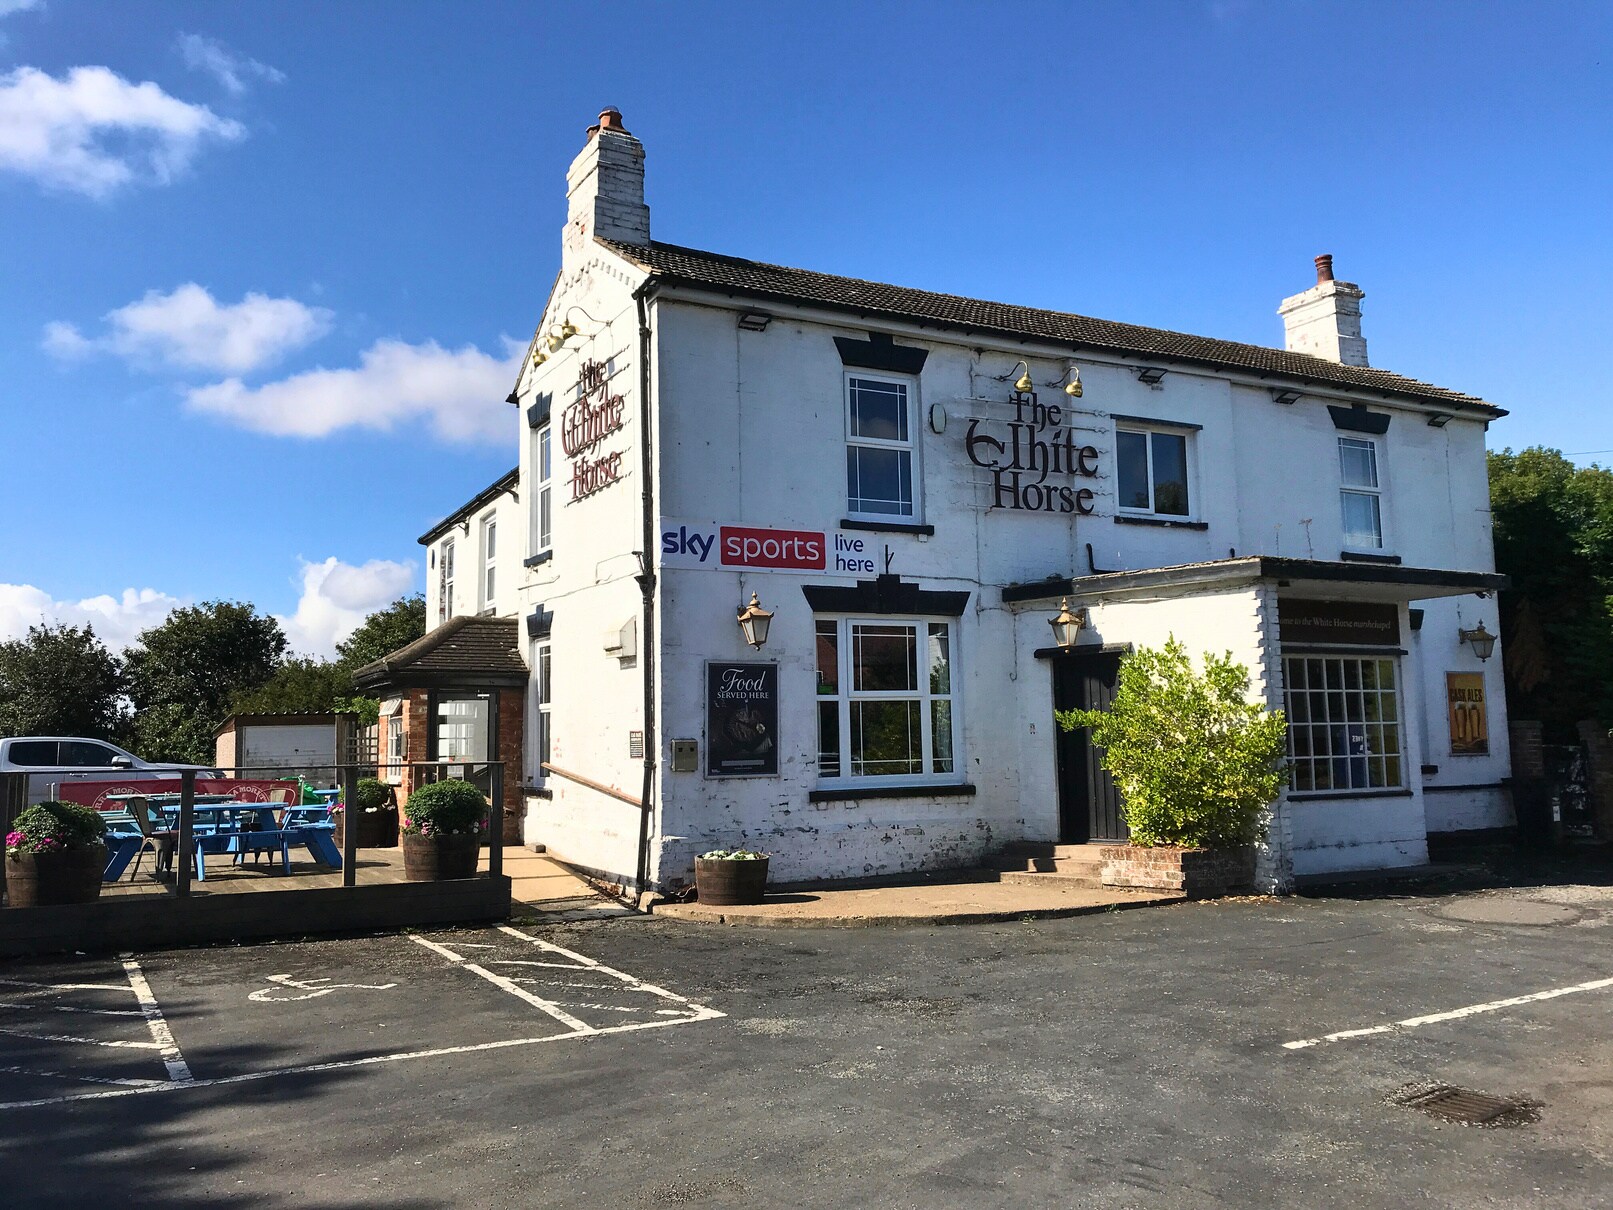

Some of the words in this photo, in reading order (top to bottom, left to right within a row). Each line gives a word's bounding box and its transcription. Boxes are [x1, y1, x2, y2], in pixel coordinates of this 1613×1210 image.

[1009, 391, 1062, 432] The
[966, 419, 1098, 484] White
[572, 451, 622, 499] Horse
[990, 468, 1094, 515] Horse
[662, 525, 715, 562] sky
[726, 535, 820, 562] sports
[835, 533, 864, 553] live
[835, 554, 874, 572] here
[1312, 617, 1332, 627] White
[1333, 618, 1353, 628] Horse
[720, 669, 766, 692] Food
[1448, 688, 1466, 702] CASK
[1466, 688, 1483, 702] ALES
